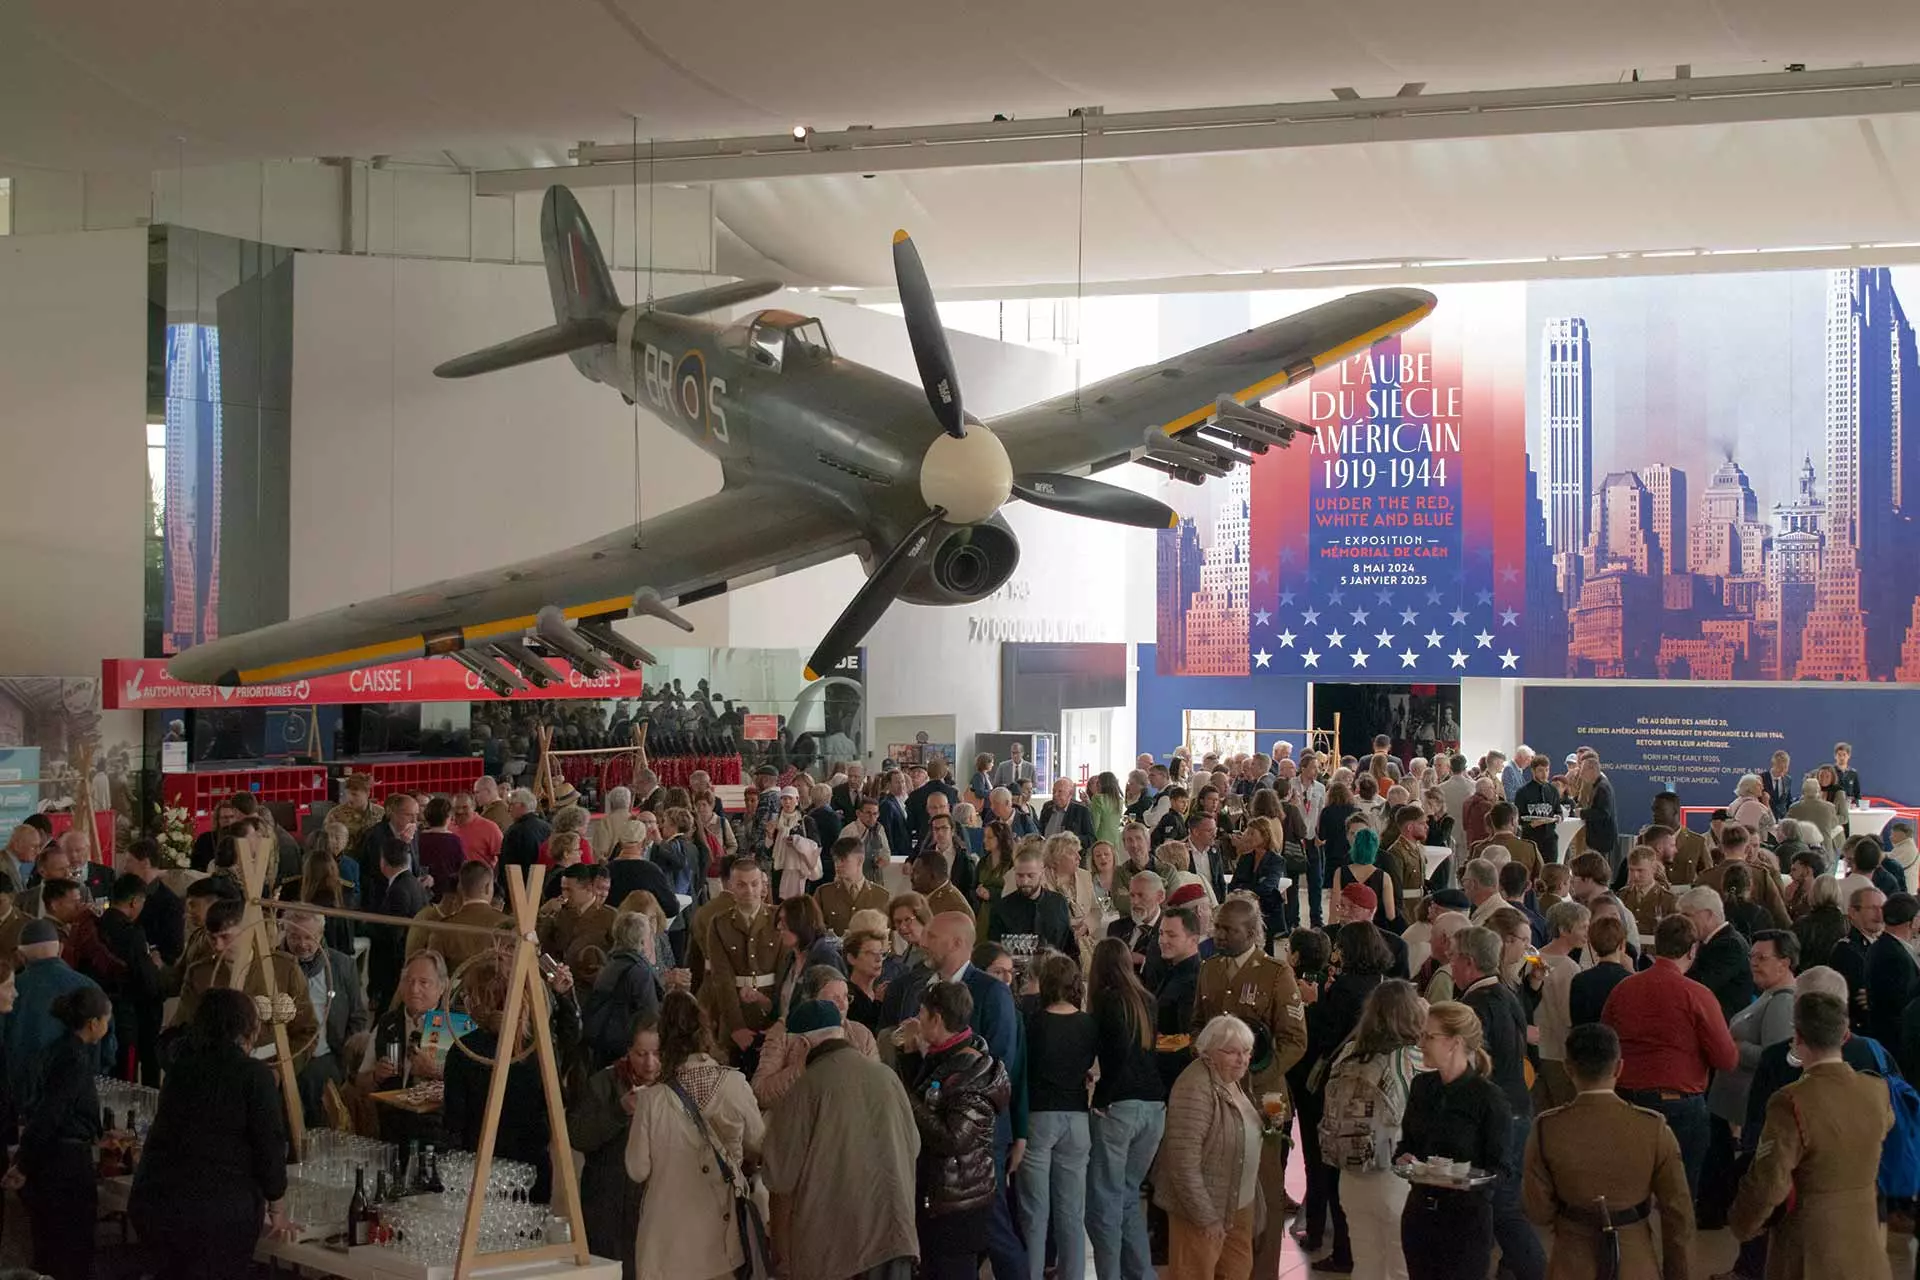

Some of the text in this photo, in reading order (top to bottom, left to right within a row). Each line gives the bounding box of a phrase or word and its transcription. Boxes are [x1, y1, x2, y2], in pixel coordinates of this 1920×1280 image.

[1341, 353, 1432, 385] L'AUBE
[1312, 381, 1461, 420] DU SIÈCLE
[709, 376, 729, 444] S
[1310, 418, 1461, 454] AMÉRICAIN
[1323, 457, 1447, 489] 1919-1944
[1315, 496, 1455, 511] UNDER THE RED,
[1315, 512, 1454, 527] WHITE AND BLUE
[1344, 535, 1423, 545] EXPOSITION
[1321, 544, 1448, 558] MÉMORIAL DE CAEN
[1353, 563, 1415, 573] 8 MAI 2024
[1340, 575, 1428, 585] 5 JANVIER 2025
[350, 669, 402, 692] CAISSE
[144, 685, 212, 698] AUTOMATIQUES
[236, 685, 292, 698] PRIORITAIRES
